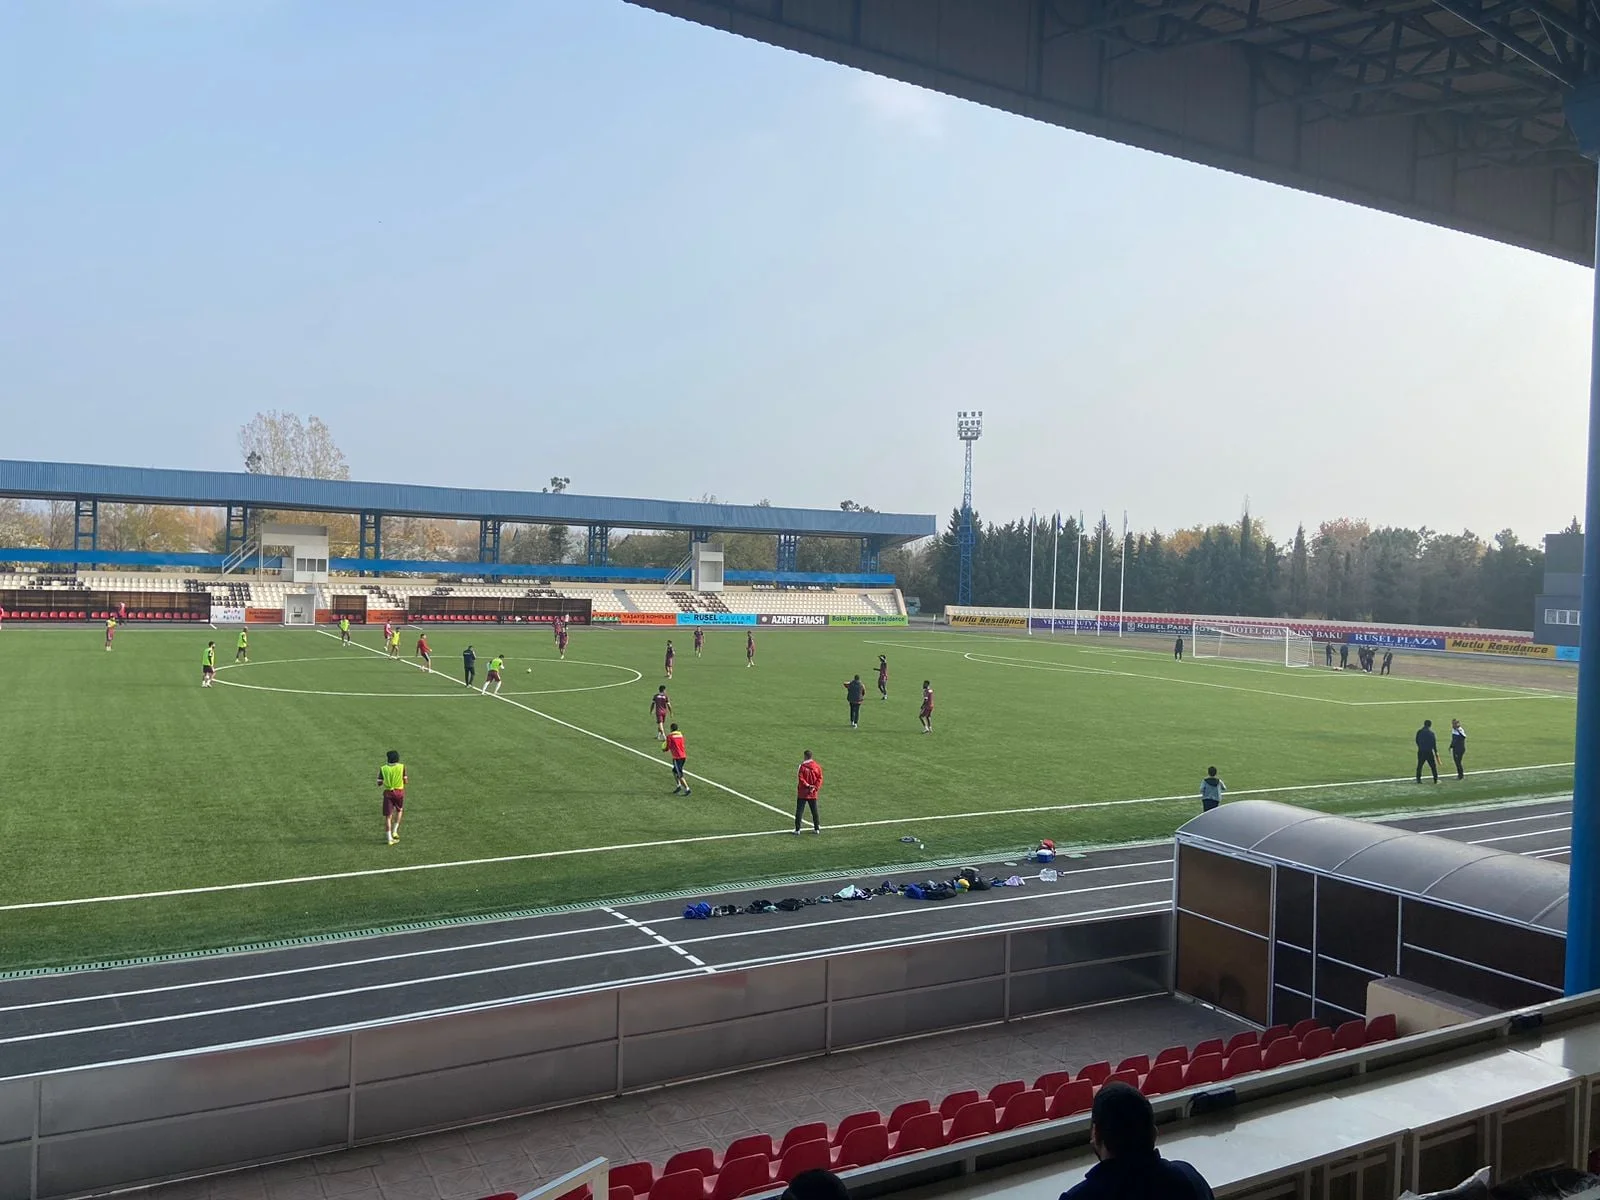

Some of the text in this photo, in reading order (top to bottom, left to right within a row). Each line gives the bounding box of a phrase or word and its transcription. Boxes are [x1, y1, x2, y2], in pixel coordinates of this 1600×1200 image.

[693, 613, 718, 621] RUSEL
[771, 615, 825, 625] AZNEFTEMASH
[951, 615, 977, 623] Mutlu
[1137, 622, 1166, 630] RUSEL
[1229, 626, 1261, 634] HOTEL
[1316, 631, 1344, 639] BAKU
[1355, 633, 1394, 643] RUSEL
[1397, 636, 1438, 646] PLAZA
[1451, 640, 1484, 649] Mutlu
